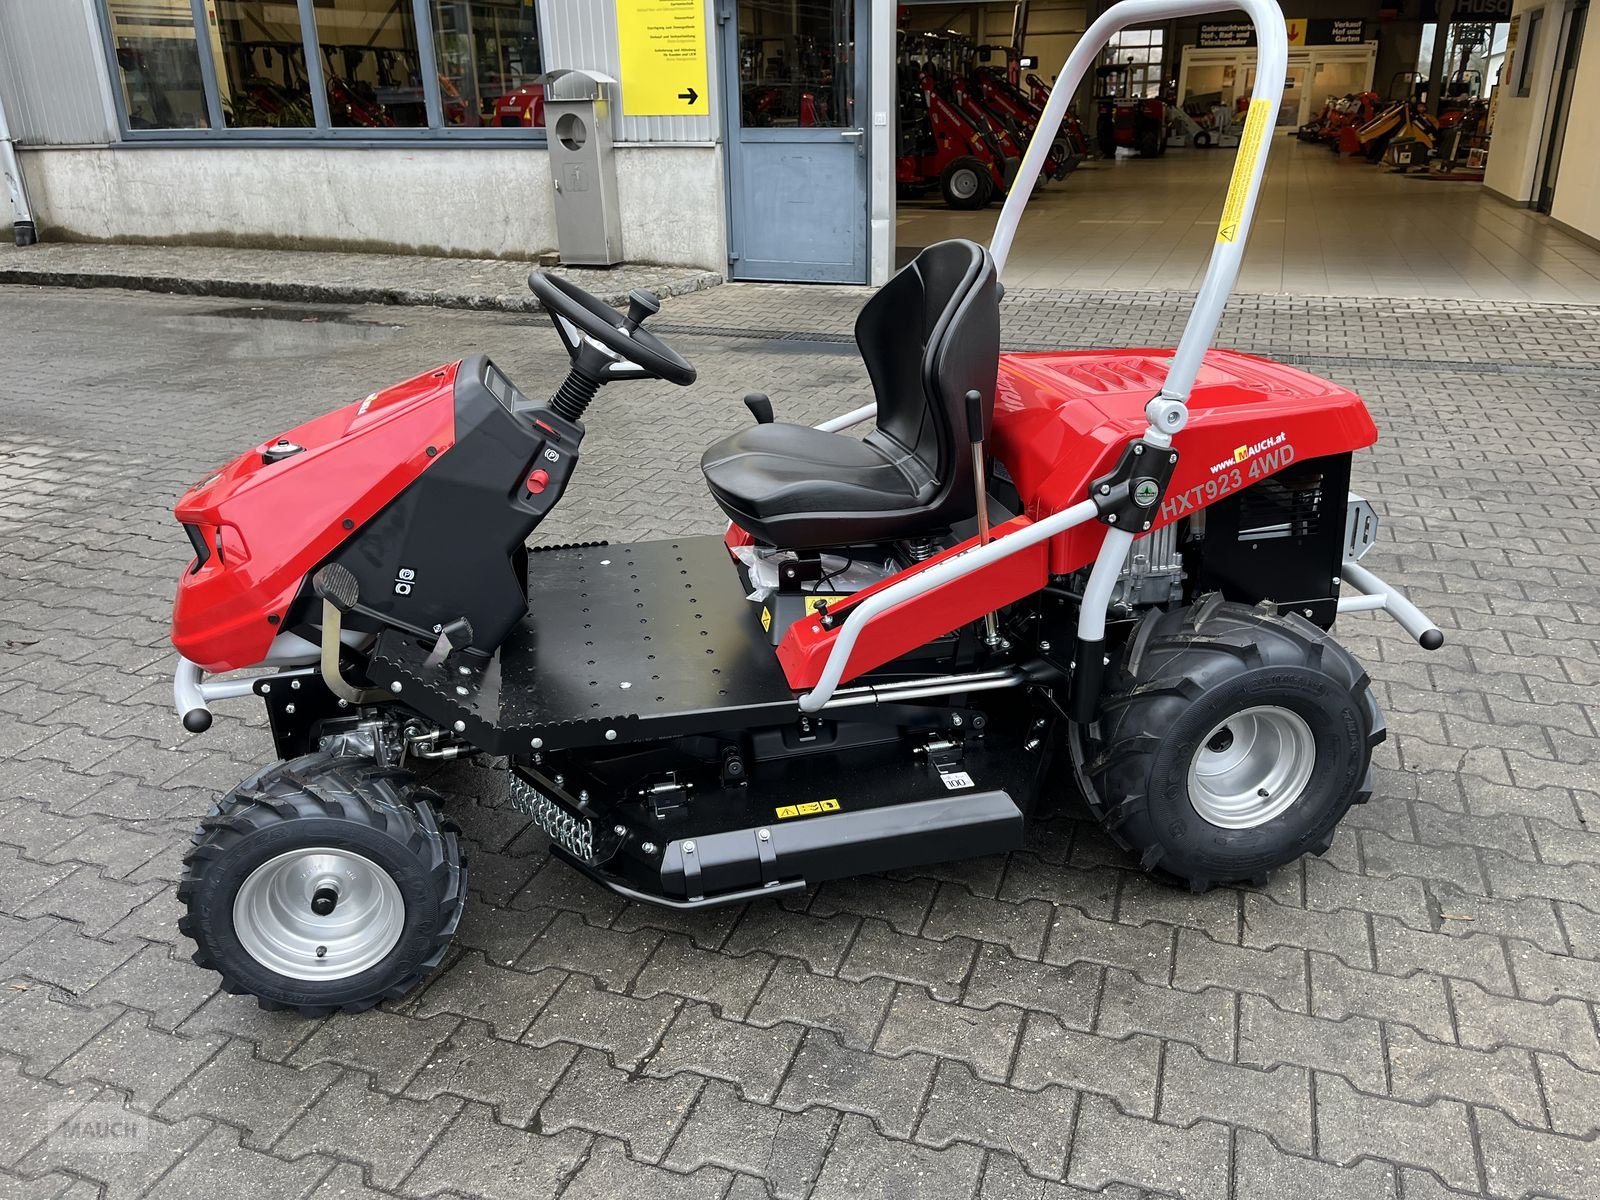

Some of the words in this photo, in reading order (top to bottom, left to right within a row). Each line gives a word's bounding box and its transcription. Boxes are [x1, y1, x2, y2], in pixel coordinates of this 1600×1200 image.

[1457, 0, 1509, 16] Husq
[1201, 24, 1255, 32] Gebrauchtverka
[1210, 431, 1287, 474] www.MAUCH.at
[1161, 469, 1243, 521] HXT923
[1248, 444, 1296, 479] 4WD
[946, 779, 966, 788] 100
